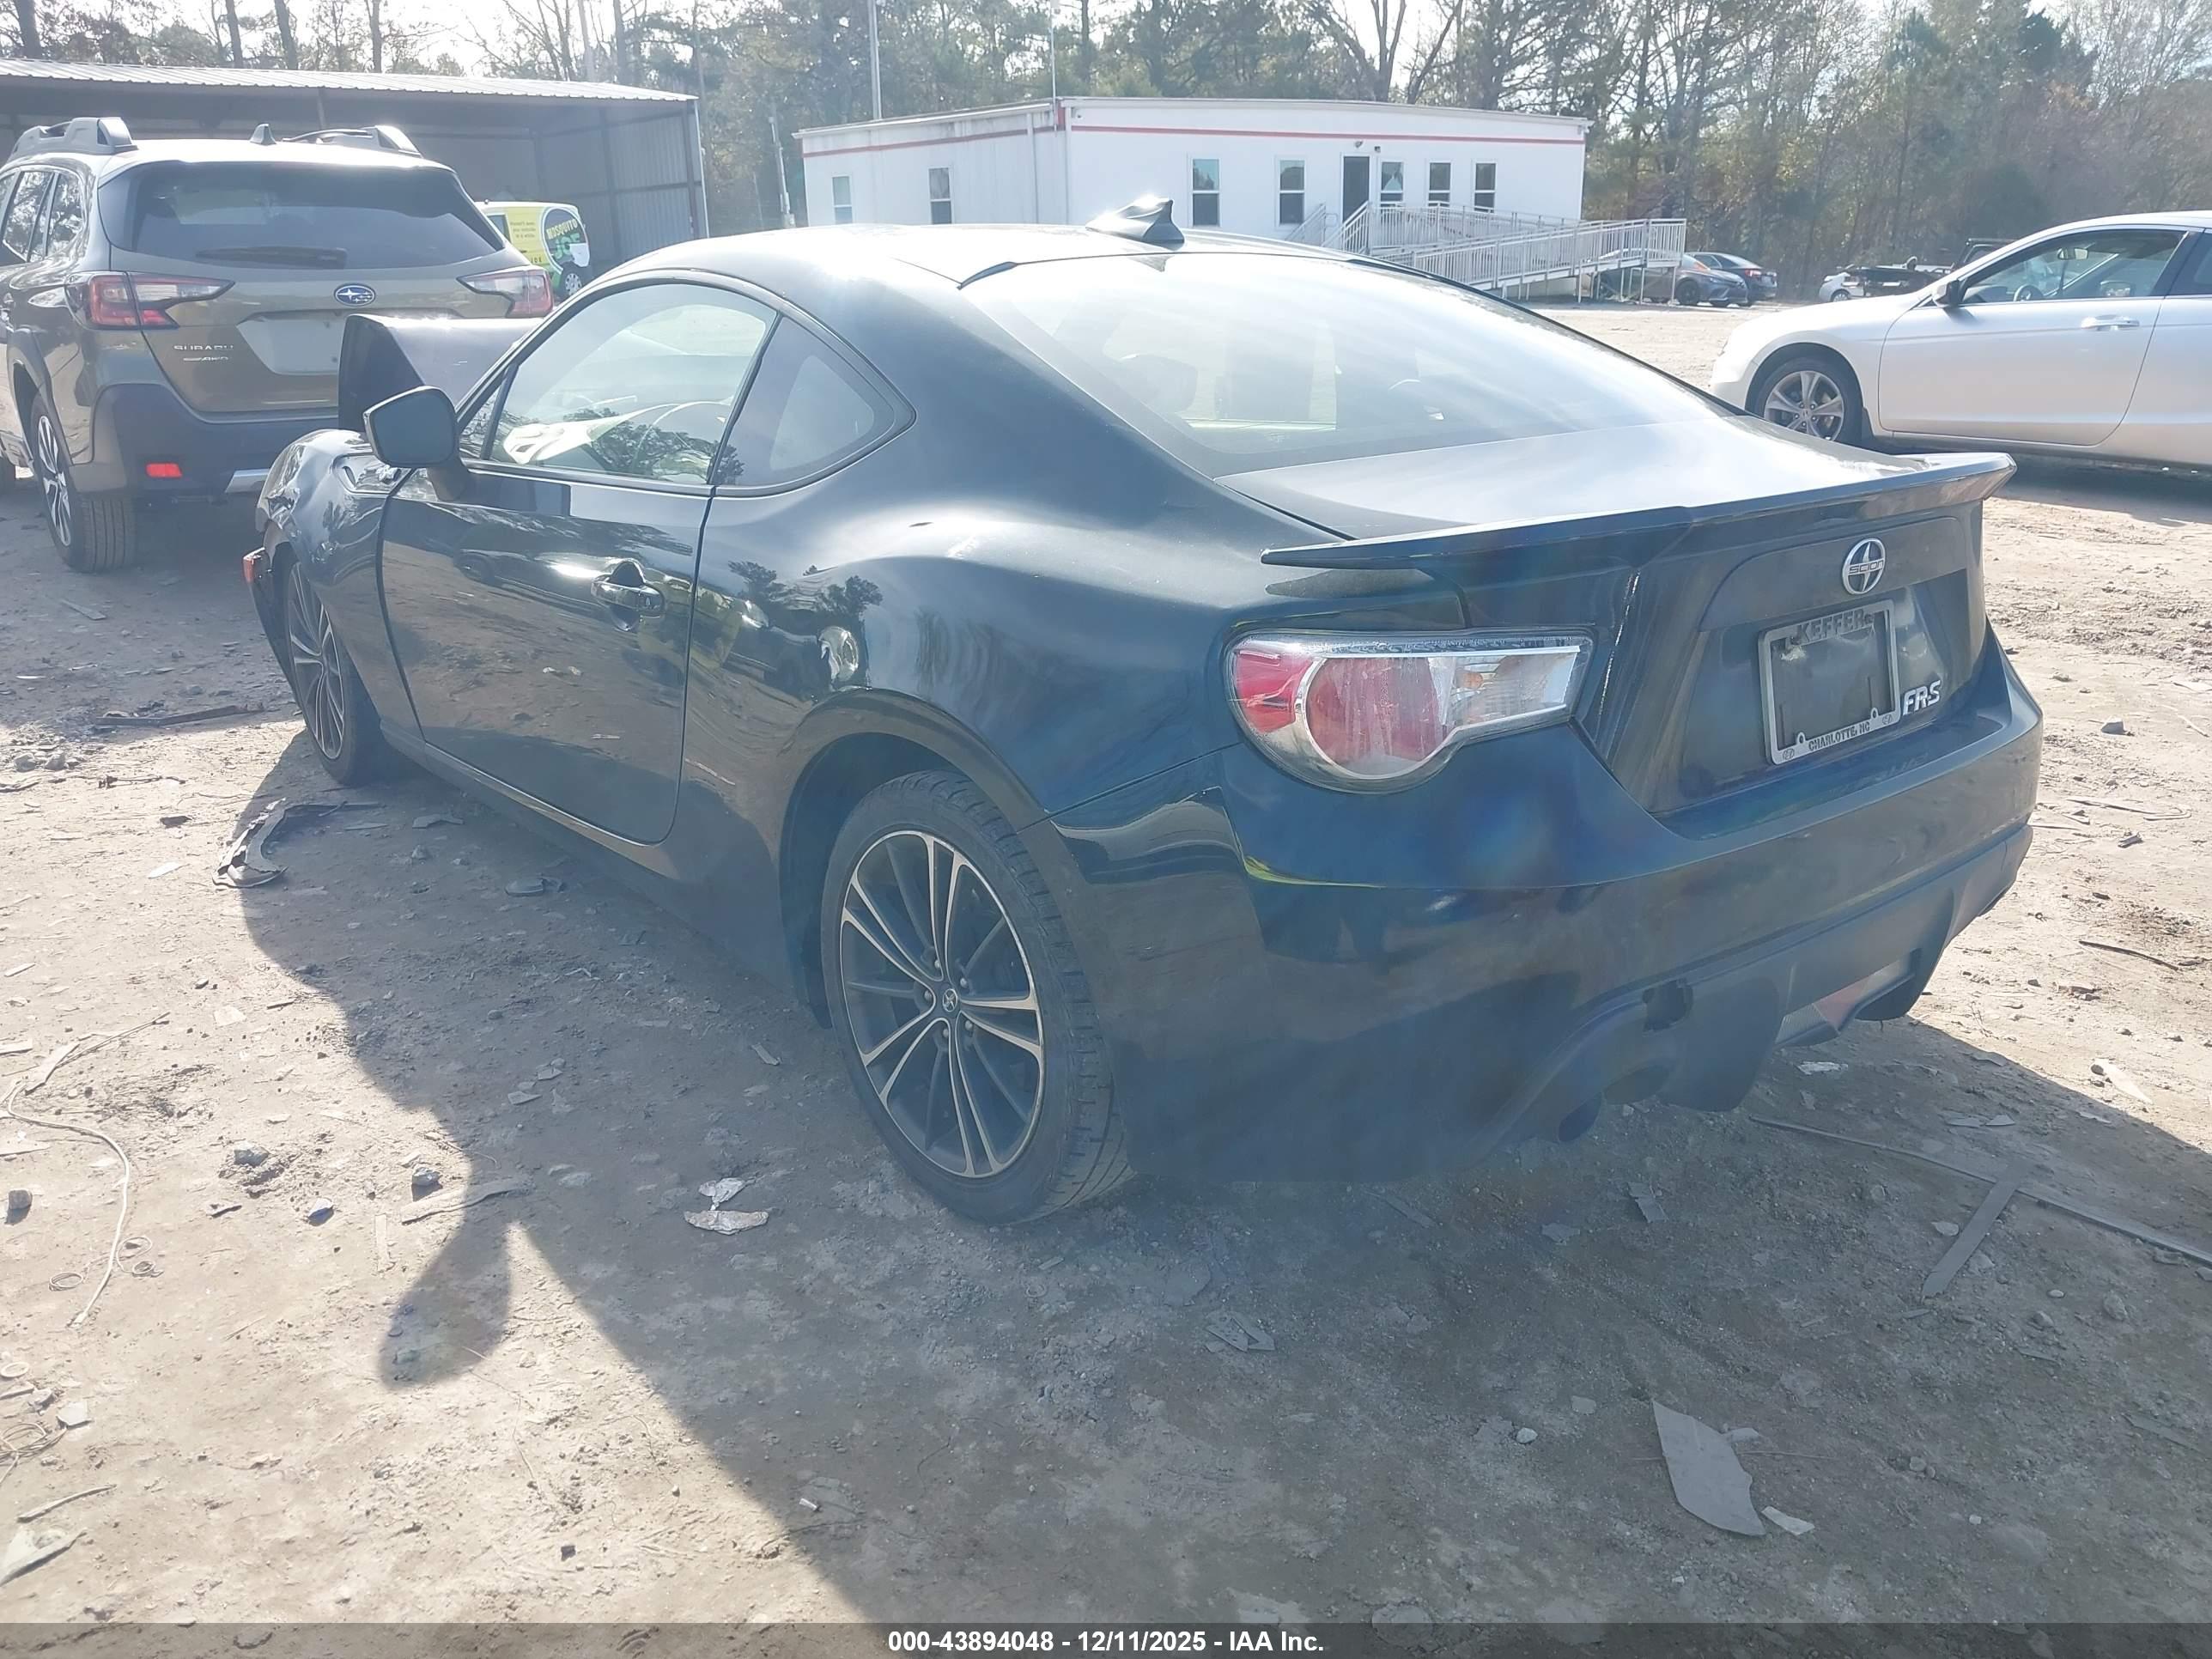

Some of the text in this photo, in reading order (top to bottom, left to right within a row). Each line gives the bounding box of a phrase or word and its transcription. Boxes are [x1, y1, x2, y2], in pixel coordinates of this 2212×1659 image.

[545, 218, 578, 240] MOSQUITO
[1849, 560, 1884, 574] SCION
[1797, 609, 1865, 642] KEFFER
[1859, 721, 1870, 732] NC
